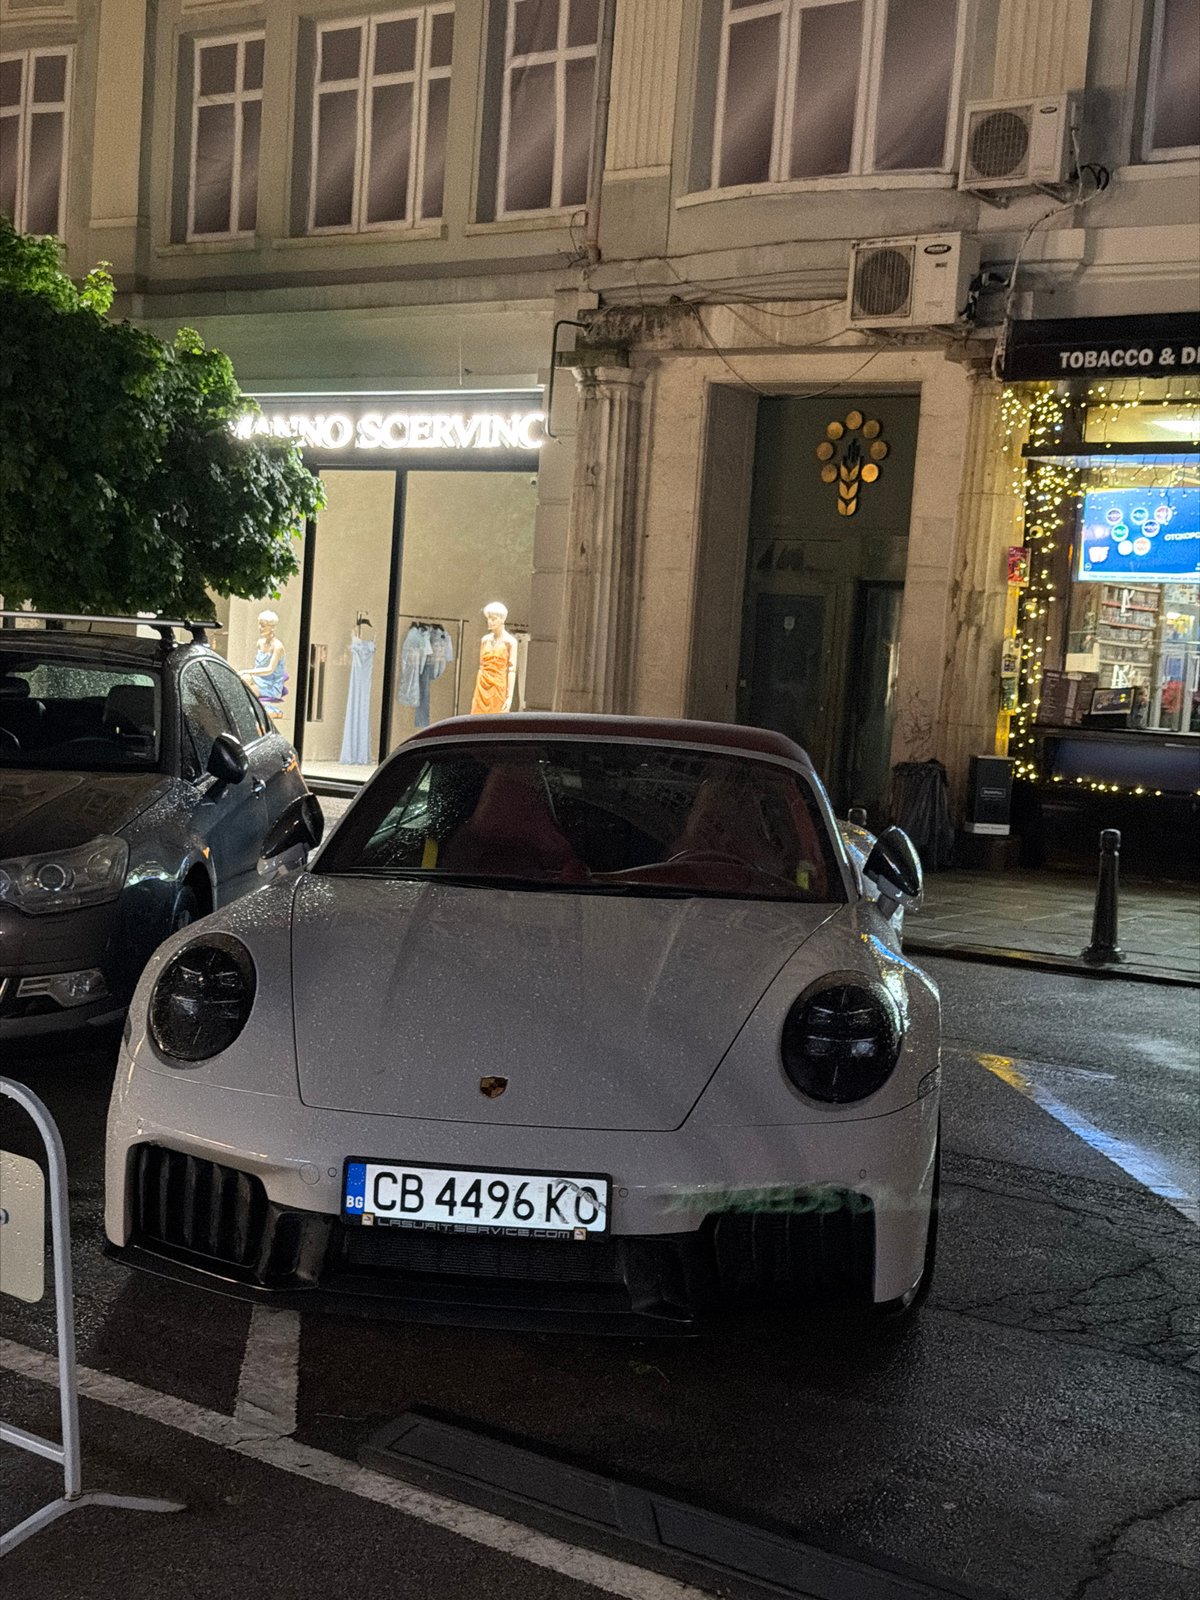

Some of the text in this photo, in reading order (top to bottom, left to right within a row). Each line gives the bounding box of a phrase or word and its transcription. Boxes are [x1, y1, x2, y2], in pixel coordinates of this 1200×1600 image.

[1059, 348, 1154, 369] TOBACCO
[1158, 347, 1176, 365] &
[346, 1195, 363, 1209] BG
[373, 1171, 599, 1225] CB 4496 KO
